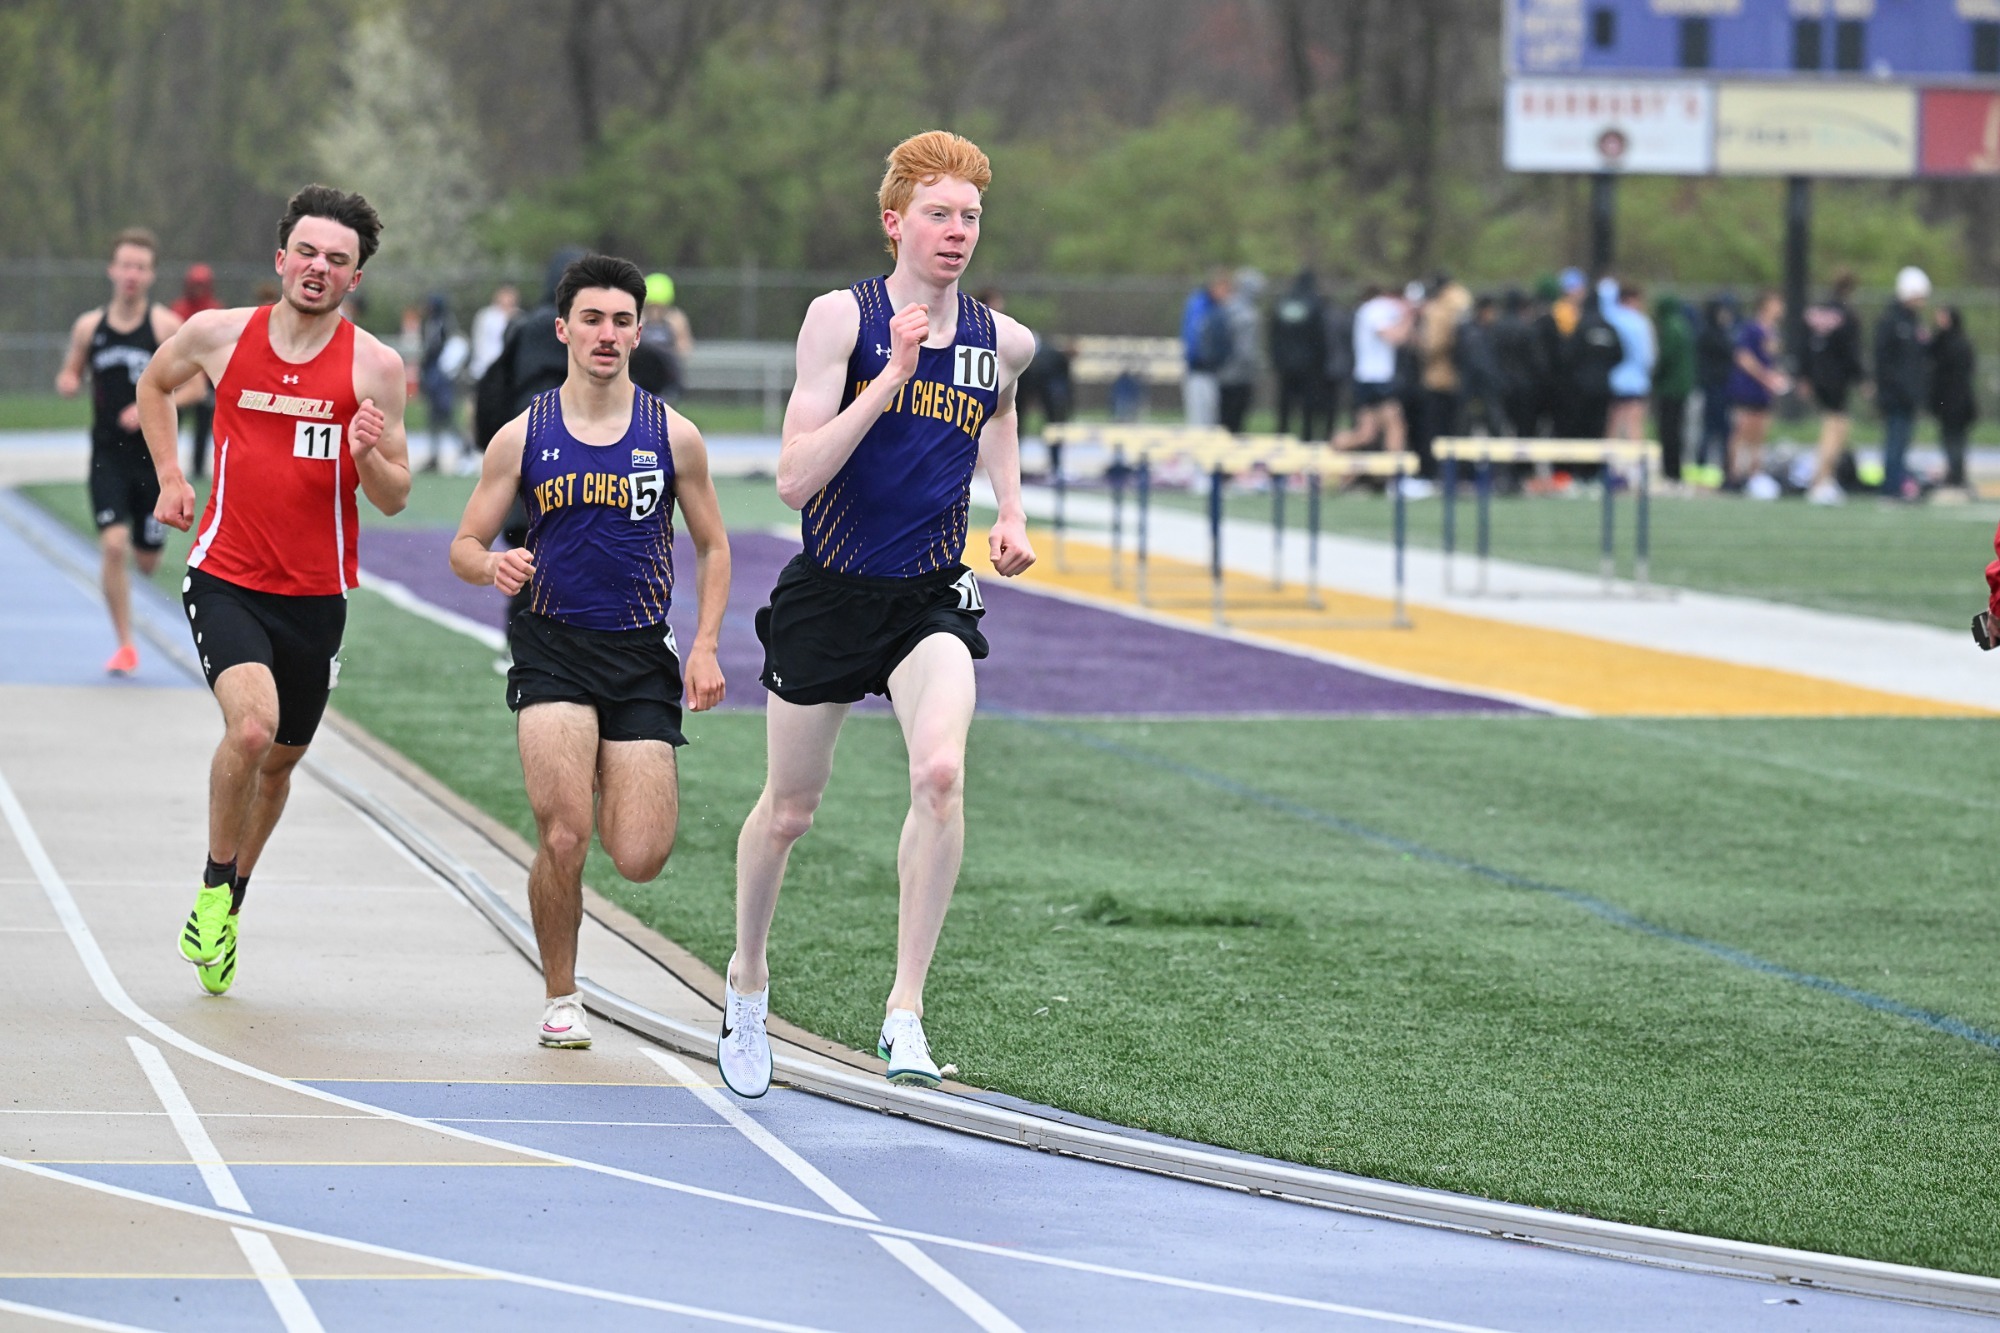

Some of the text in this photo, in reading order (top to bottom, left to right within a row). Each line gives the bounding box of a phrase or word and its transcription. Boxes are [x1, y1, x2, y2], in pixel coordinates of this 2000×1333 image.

[958, 348, 996, 389] 10
[911, 379, 985, 441] CHESTER
[303, 425, 332, 458] 11
[632, 454, 657, 464] PSAC
[534, 472, 630, 516] WEST CHES
[635, 474, 658, 516] 5
